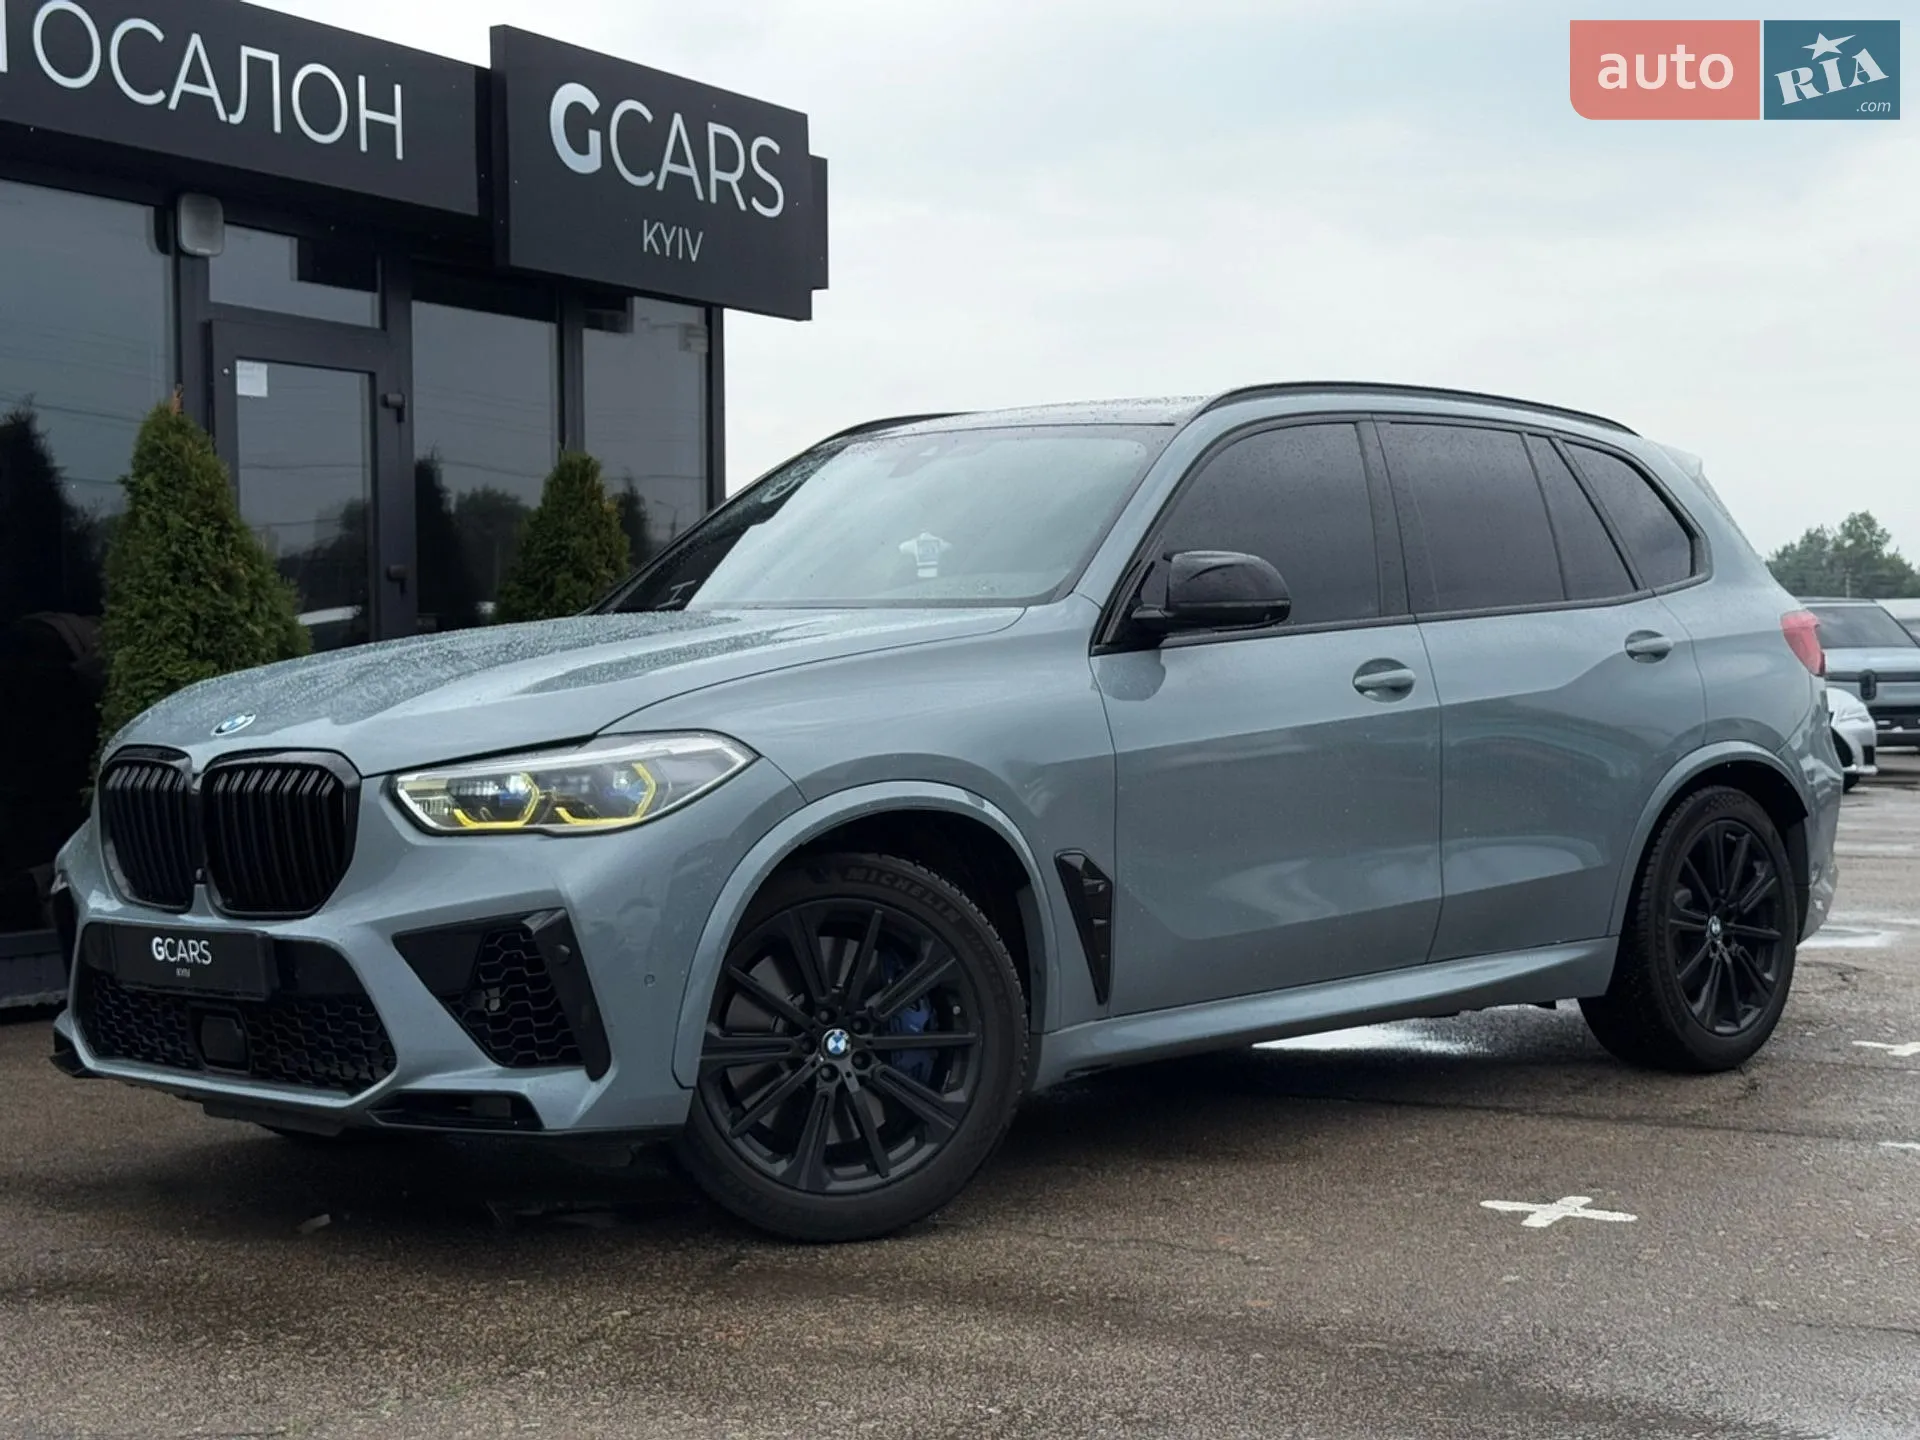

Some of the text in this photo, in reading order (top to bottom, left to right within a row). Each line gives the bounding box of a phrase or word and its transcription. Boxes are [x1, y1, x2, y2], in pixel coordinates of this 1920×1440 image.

[549, 82, 785, 218] GCARS
[642, 219, 704, 262] KYIV
[845, 866, 962, 924] MICHELIN
[151, 936, 212, 966] GCARS
